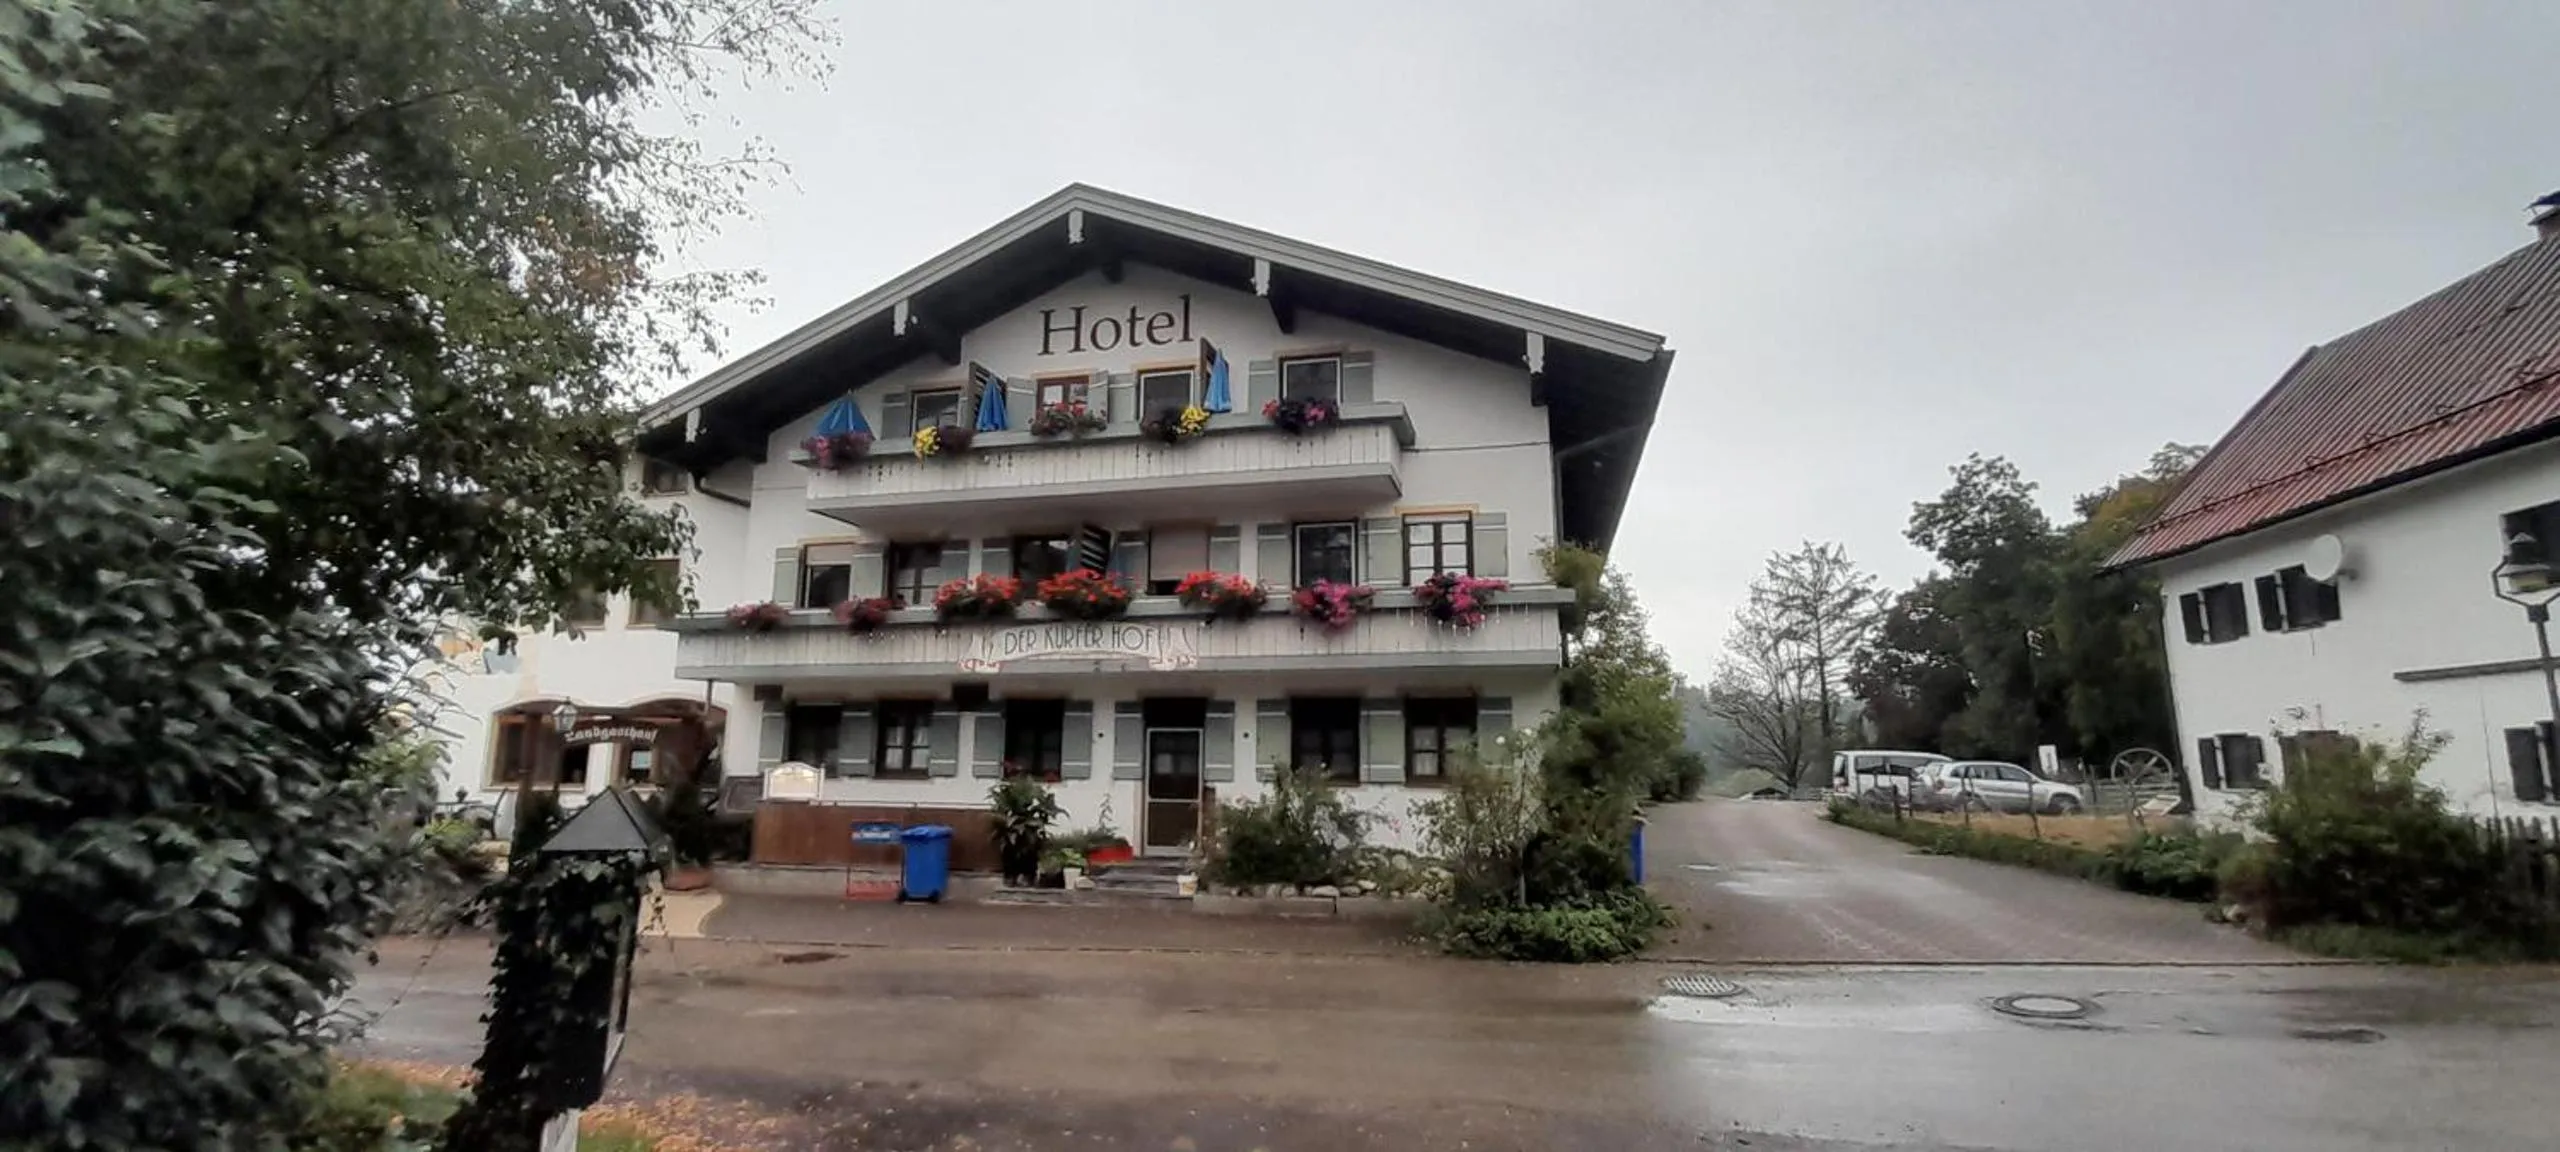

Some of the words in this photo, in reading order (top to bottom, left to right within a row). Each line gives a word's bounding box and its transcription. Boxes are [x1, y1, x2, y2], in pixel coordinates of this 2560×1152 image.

[1037, 293, 1195, 356] Hotel
[1004, 627, 1037, 656] DER
[1111, 620, 1155, 652] HOF
